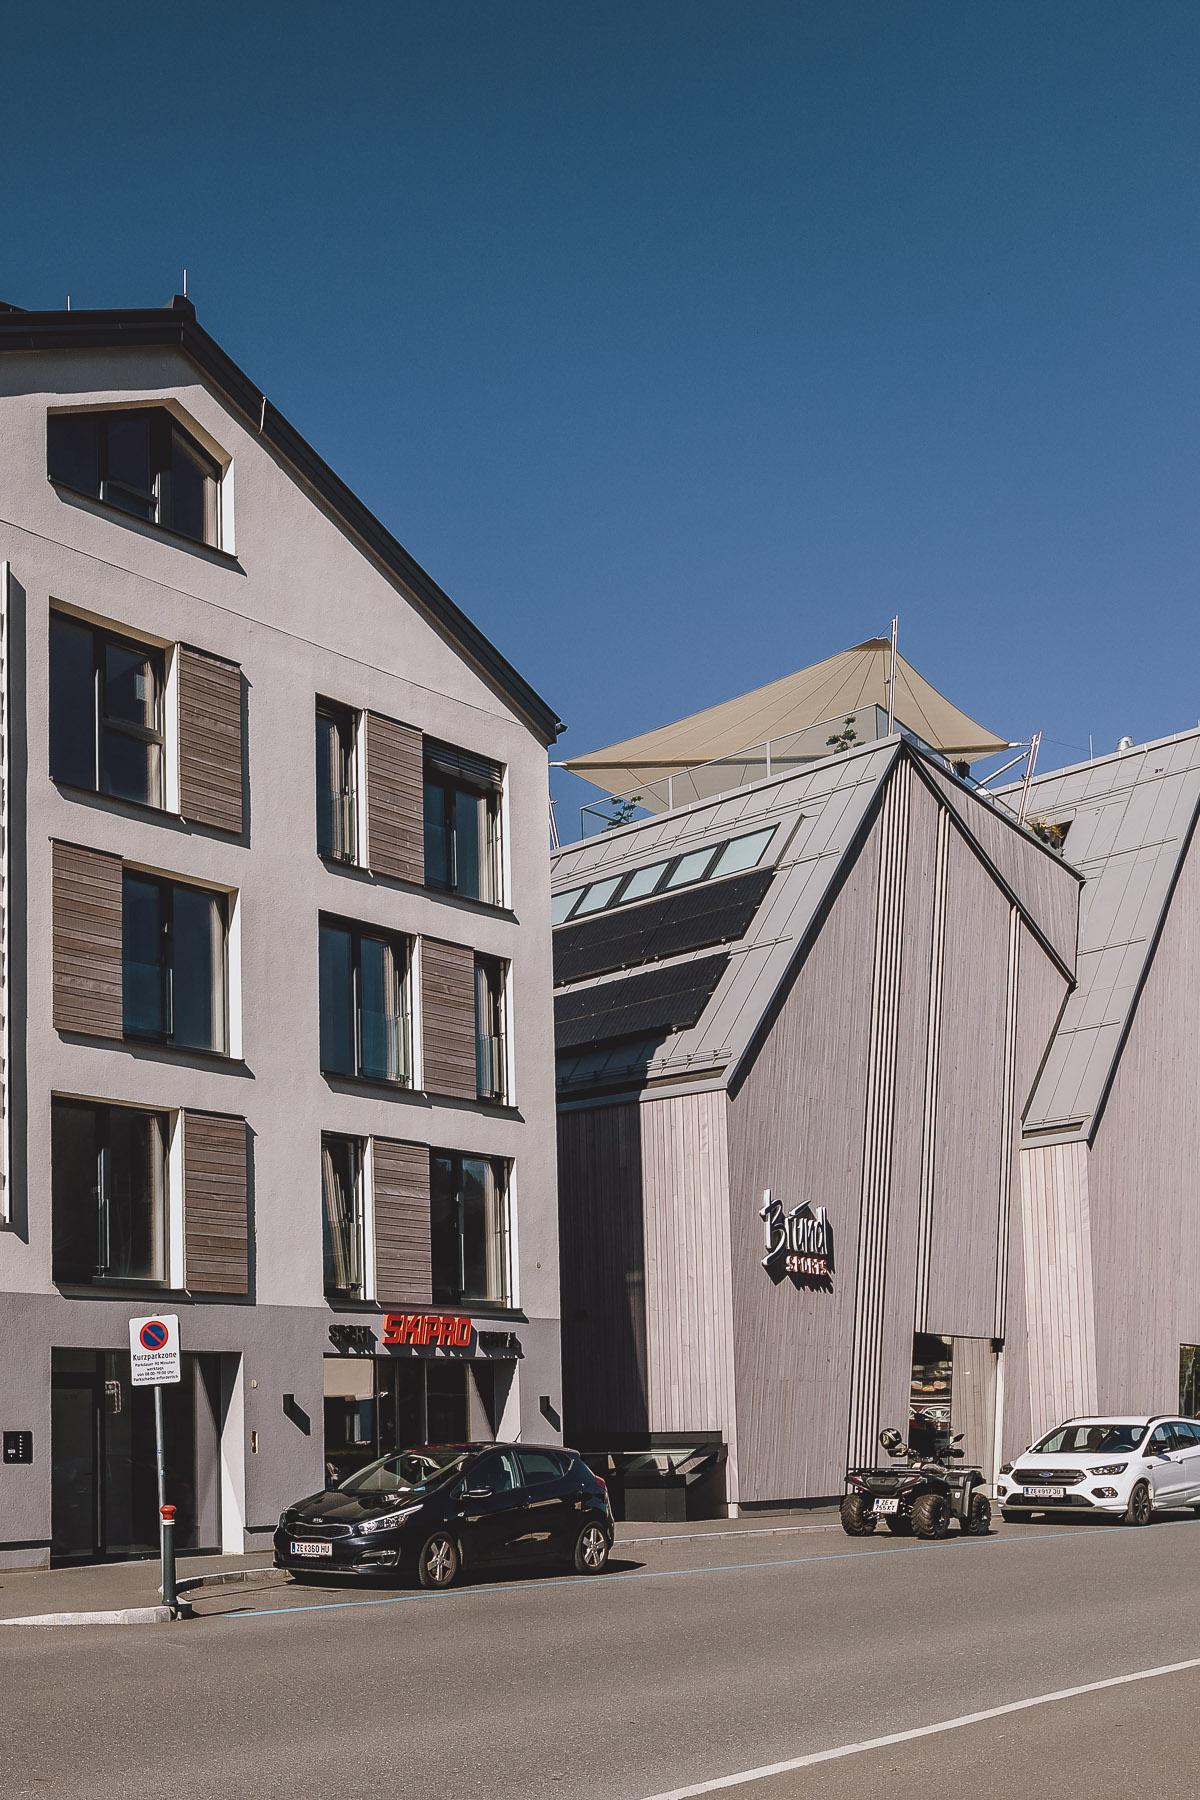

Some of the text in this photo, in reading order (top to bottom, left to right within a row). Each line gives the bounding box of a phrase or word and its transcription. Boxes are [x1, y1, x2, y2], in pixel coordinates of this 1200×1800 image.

[785, 1255, 828, 1275] SPORTS
[382, 1314, 472, 1347] SKIPRO
[133, 1352, 176, 1361] Kurzparkzone
